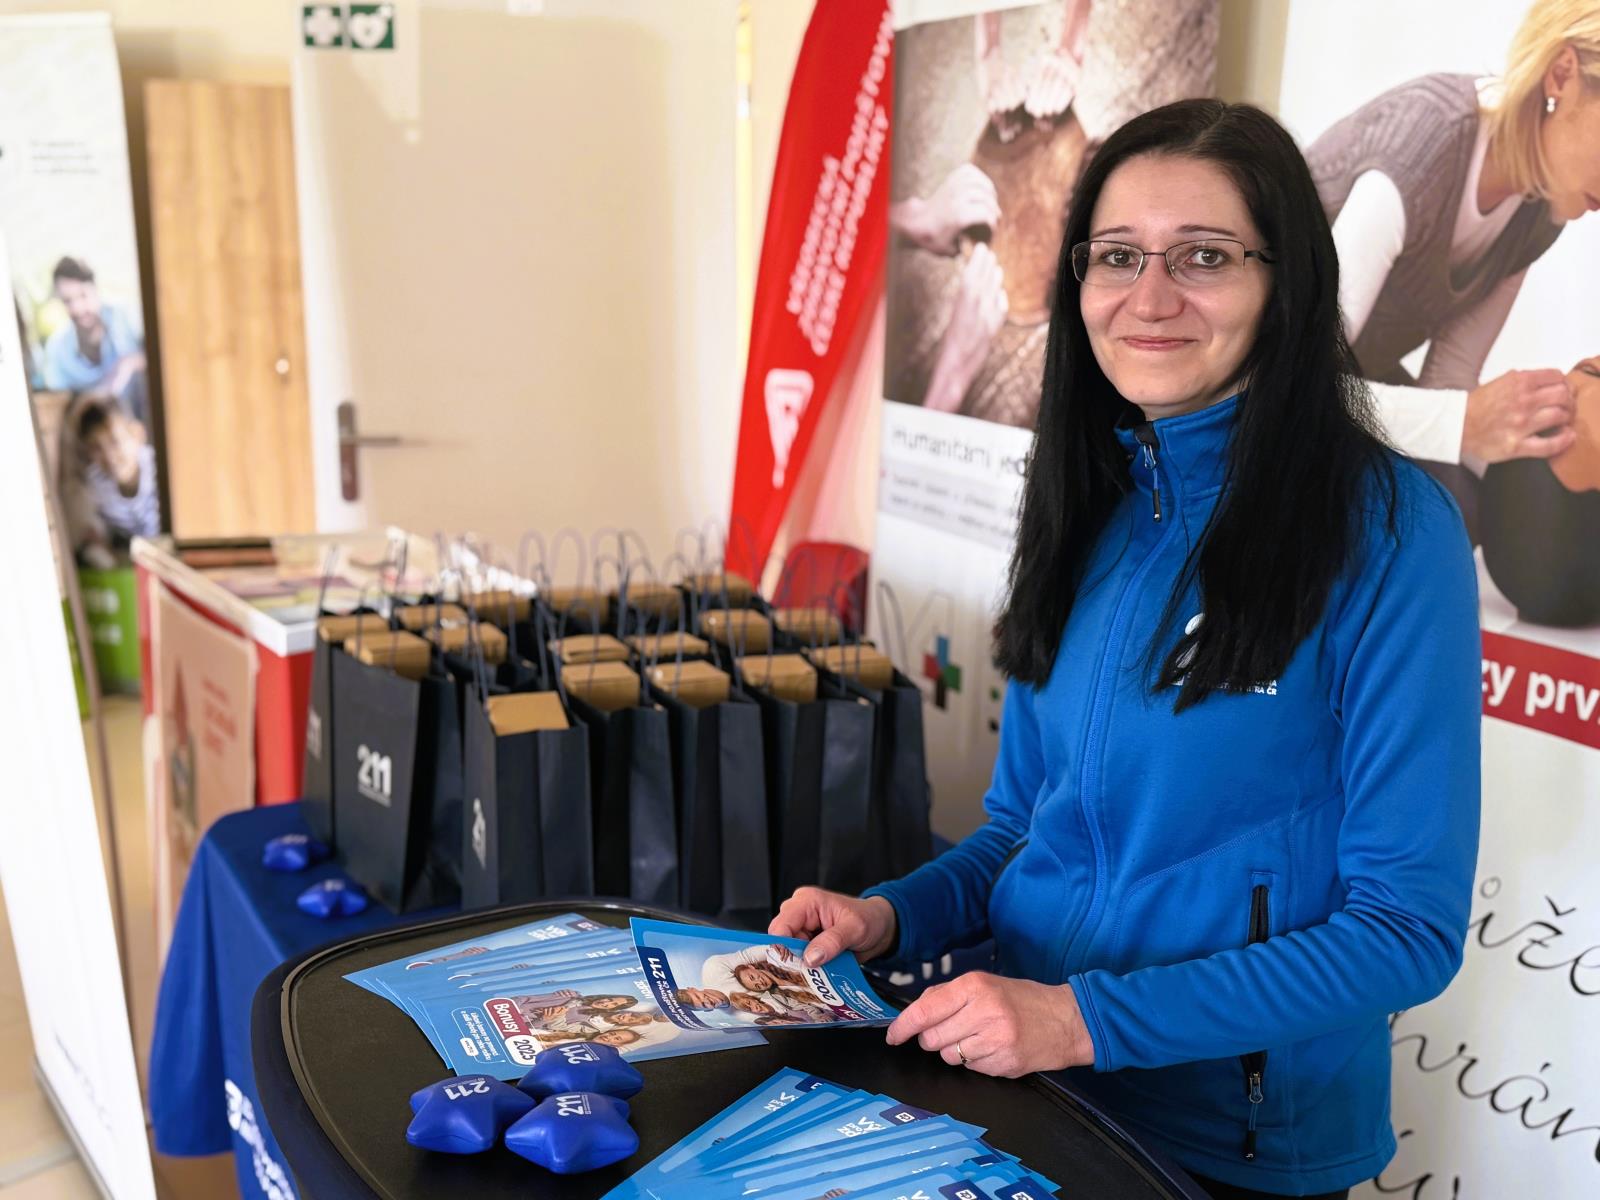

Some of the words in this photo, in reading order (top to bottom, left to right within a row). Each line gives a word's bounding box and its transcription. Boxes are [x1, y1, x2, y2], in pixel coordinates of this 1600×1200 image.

[1524, 671, 1600, 723] prv
[357, 744, 392, 797] 211
[648, 957, 666, 979] 211
[808, 968, 837, 1001] 2025
[493, 1003, 520, 1033] Bonusy
[513, 1039, 537, 1061] 2025
[558, 1044, 593, 1064] 211
[444, 1080, 490, 1100] 211
[555, 1095, 584, 1116] 211
